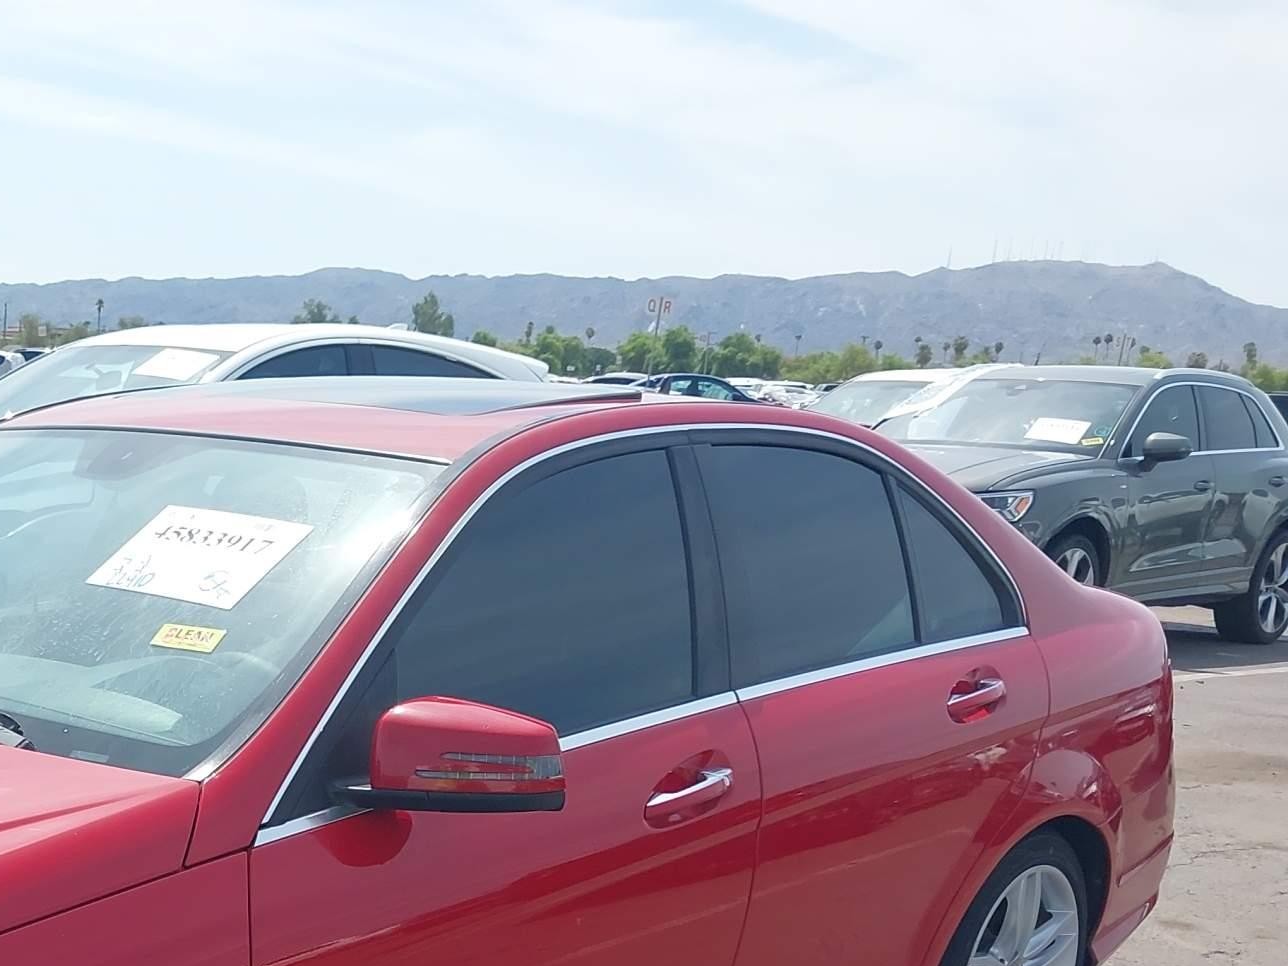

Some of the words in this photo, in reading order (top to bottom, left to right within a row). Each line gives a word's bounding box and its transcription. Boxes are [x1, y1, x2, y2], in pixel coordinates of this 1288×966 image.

[648, 298, 657, 313] Q
[664, 300, 672, 313] R
[154, 525, 275, 554] 45833917
